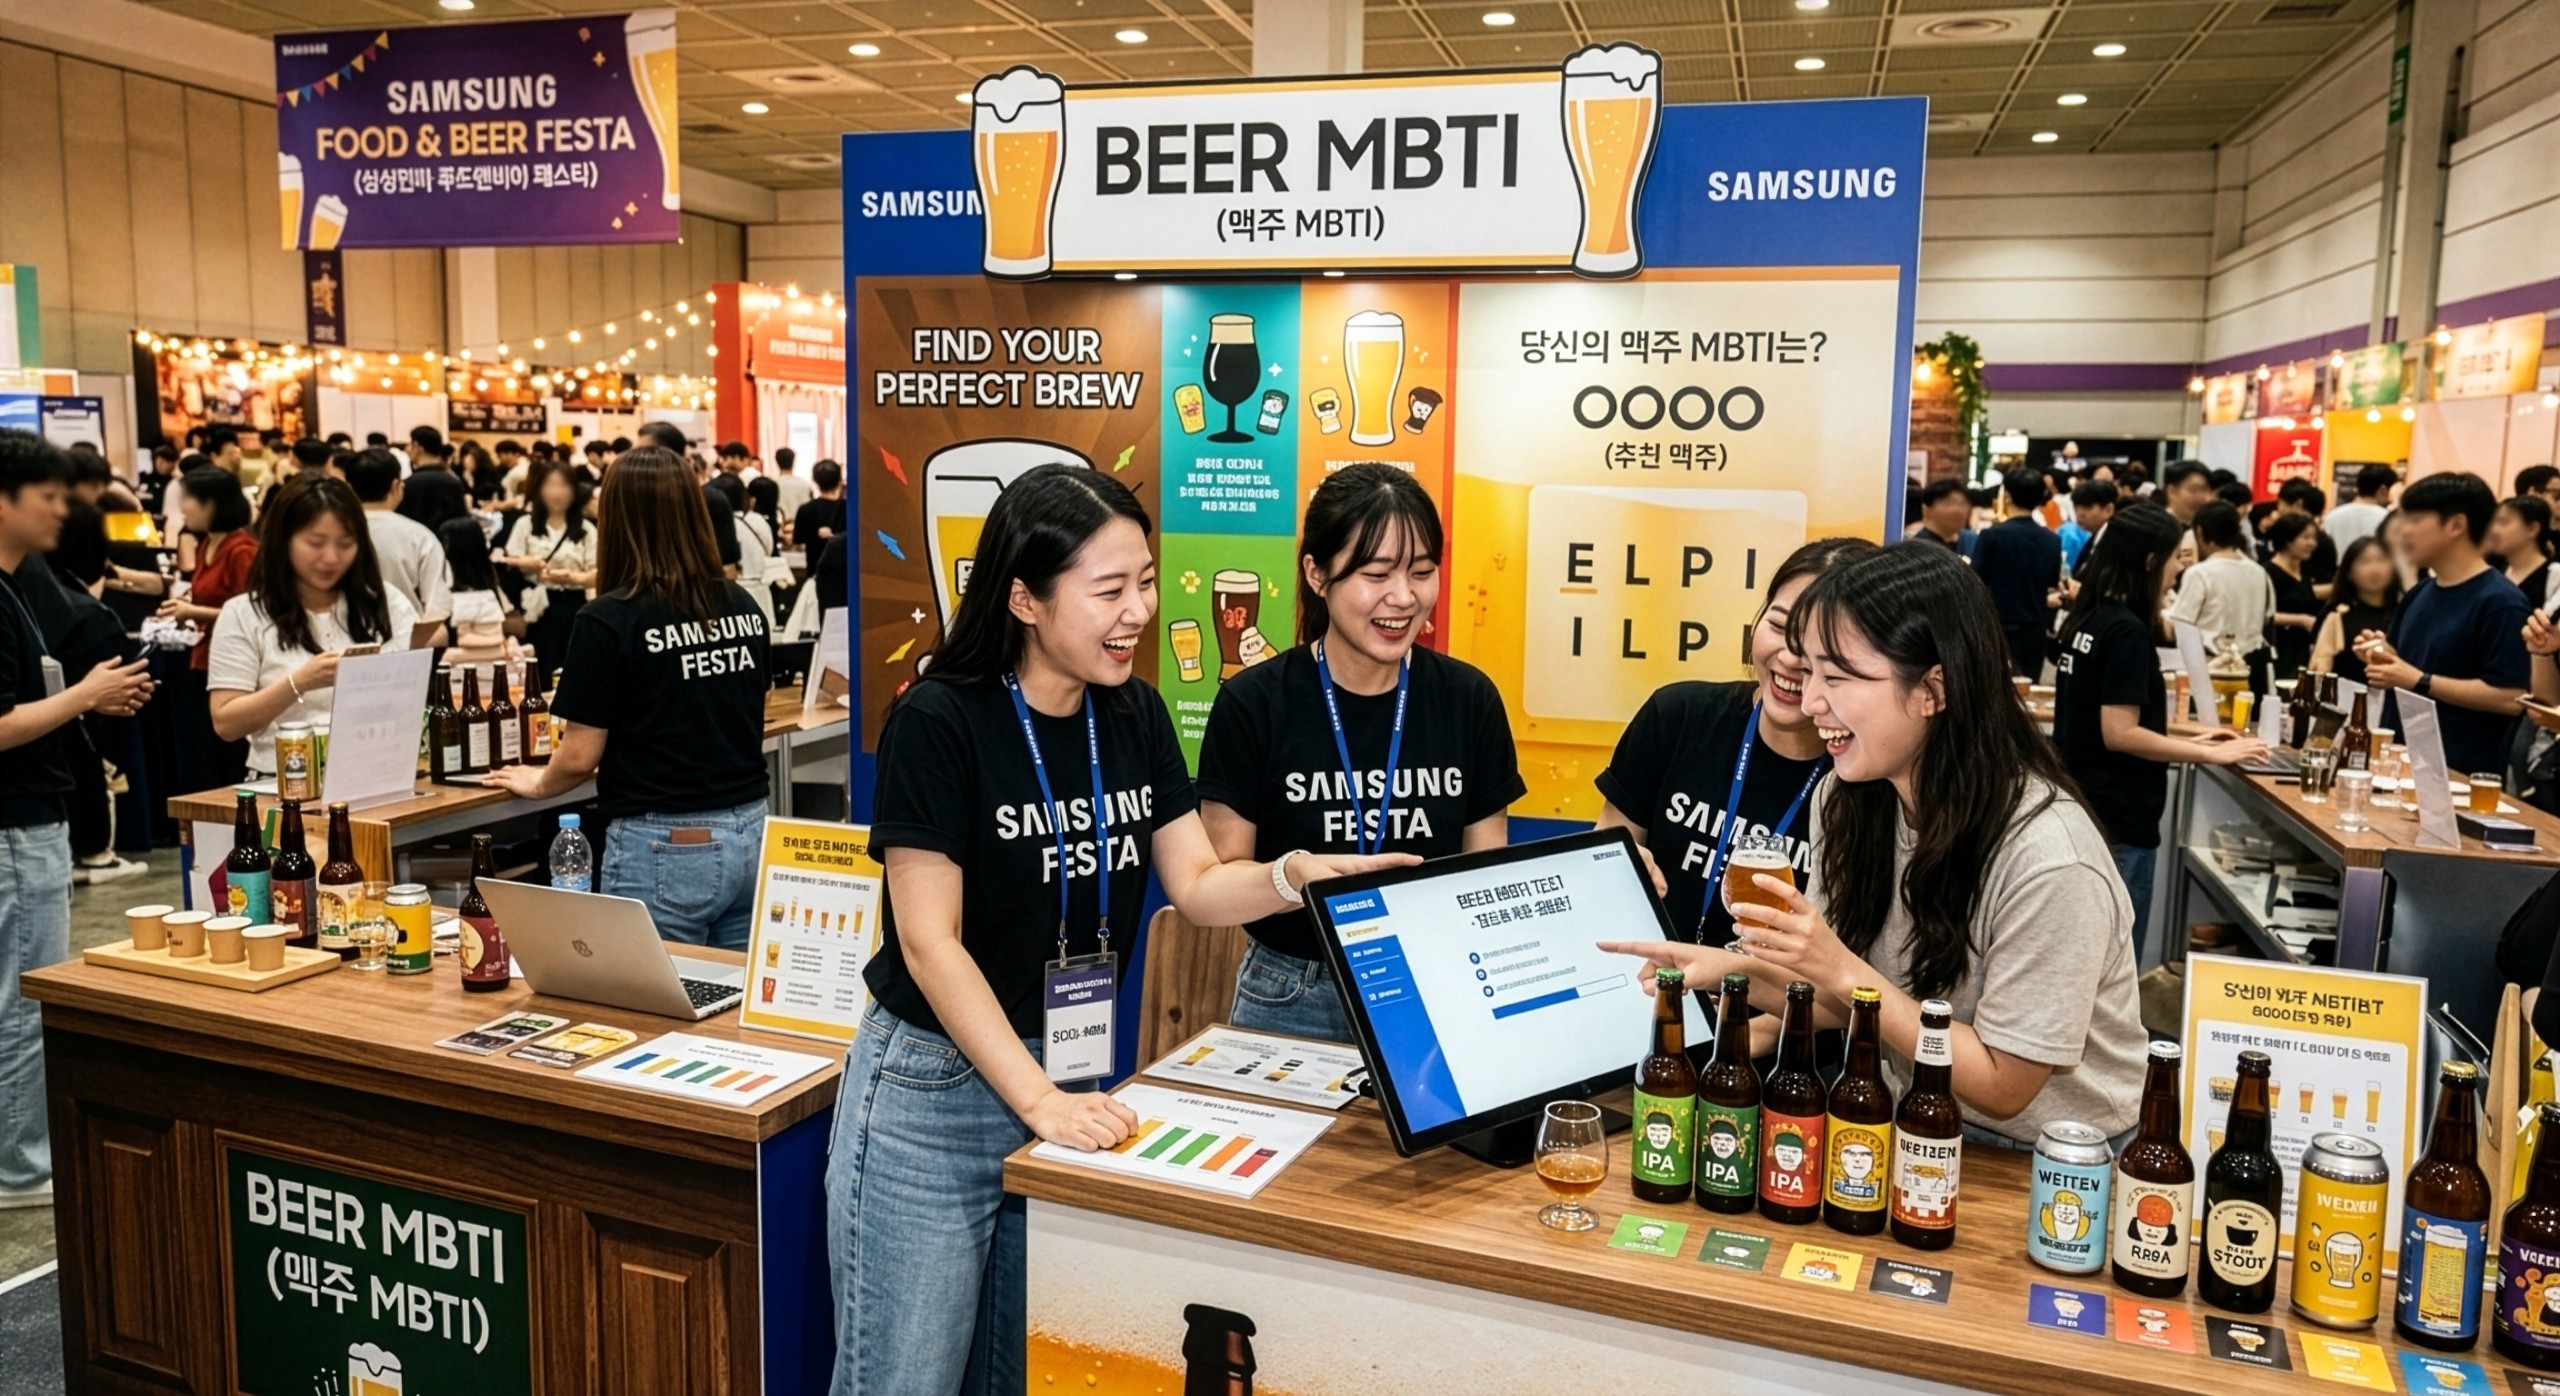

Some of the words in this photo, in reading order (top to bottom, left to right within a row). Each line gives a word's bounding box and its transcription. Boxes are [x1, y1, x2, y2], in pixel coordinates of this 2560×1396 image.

[387, 73, 558, 115] SAMSUNG
[316, 126, 409, 161] FOOD
[415, 124, 442, 158] &
[449, 120, 528, 156] BEER
[536, 115, 637, 153] FESTA
[1096, 122, 1289, 196] BEER
[1317, 113, 1520, 192] MBTI
[1708, 167, 1896, 201] SAMSUNG
[862, 190, 982, 218] SAMSUN
[1296, 205, 1385, 242] MBTI)
[912, 329, 992, 361] FIND
[1001, 329, 1101, 363] YOUR
[1521, 330, 1610, 364] 당신의
[1621, 330, 1682, 364] 맥주
[1691, 331, 1828, 363] MBTI는?
[876, 372, 1026, 405] PERFECT
[1035, 373, 1141, 407] BREW
[681, 645, 756, 680] FESTA
[1285, 767, 1463, 803] SAMSUNG
[995, 785, 1152, 840] SAMSUNG
[1323, 807, 1433, 842] FESTA
[1042, 834, 1140, 883] FESTA
[1641, 1151, 1675, 1171] IPA
[1705, 1161, 1739, 1183] IPA
[1770, 1170, 1804, 1193] IPA
[247, 1171, 366, 1250] BEER
[381, 1202, 504, 1285] MBTI
[267, 1246, 358, 1314] (맥주
[370, 1274, 490, 1354] MBTI)
